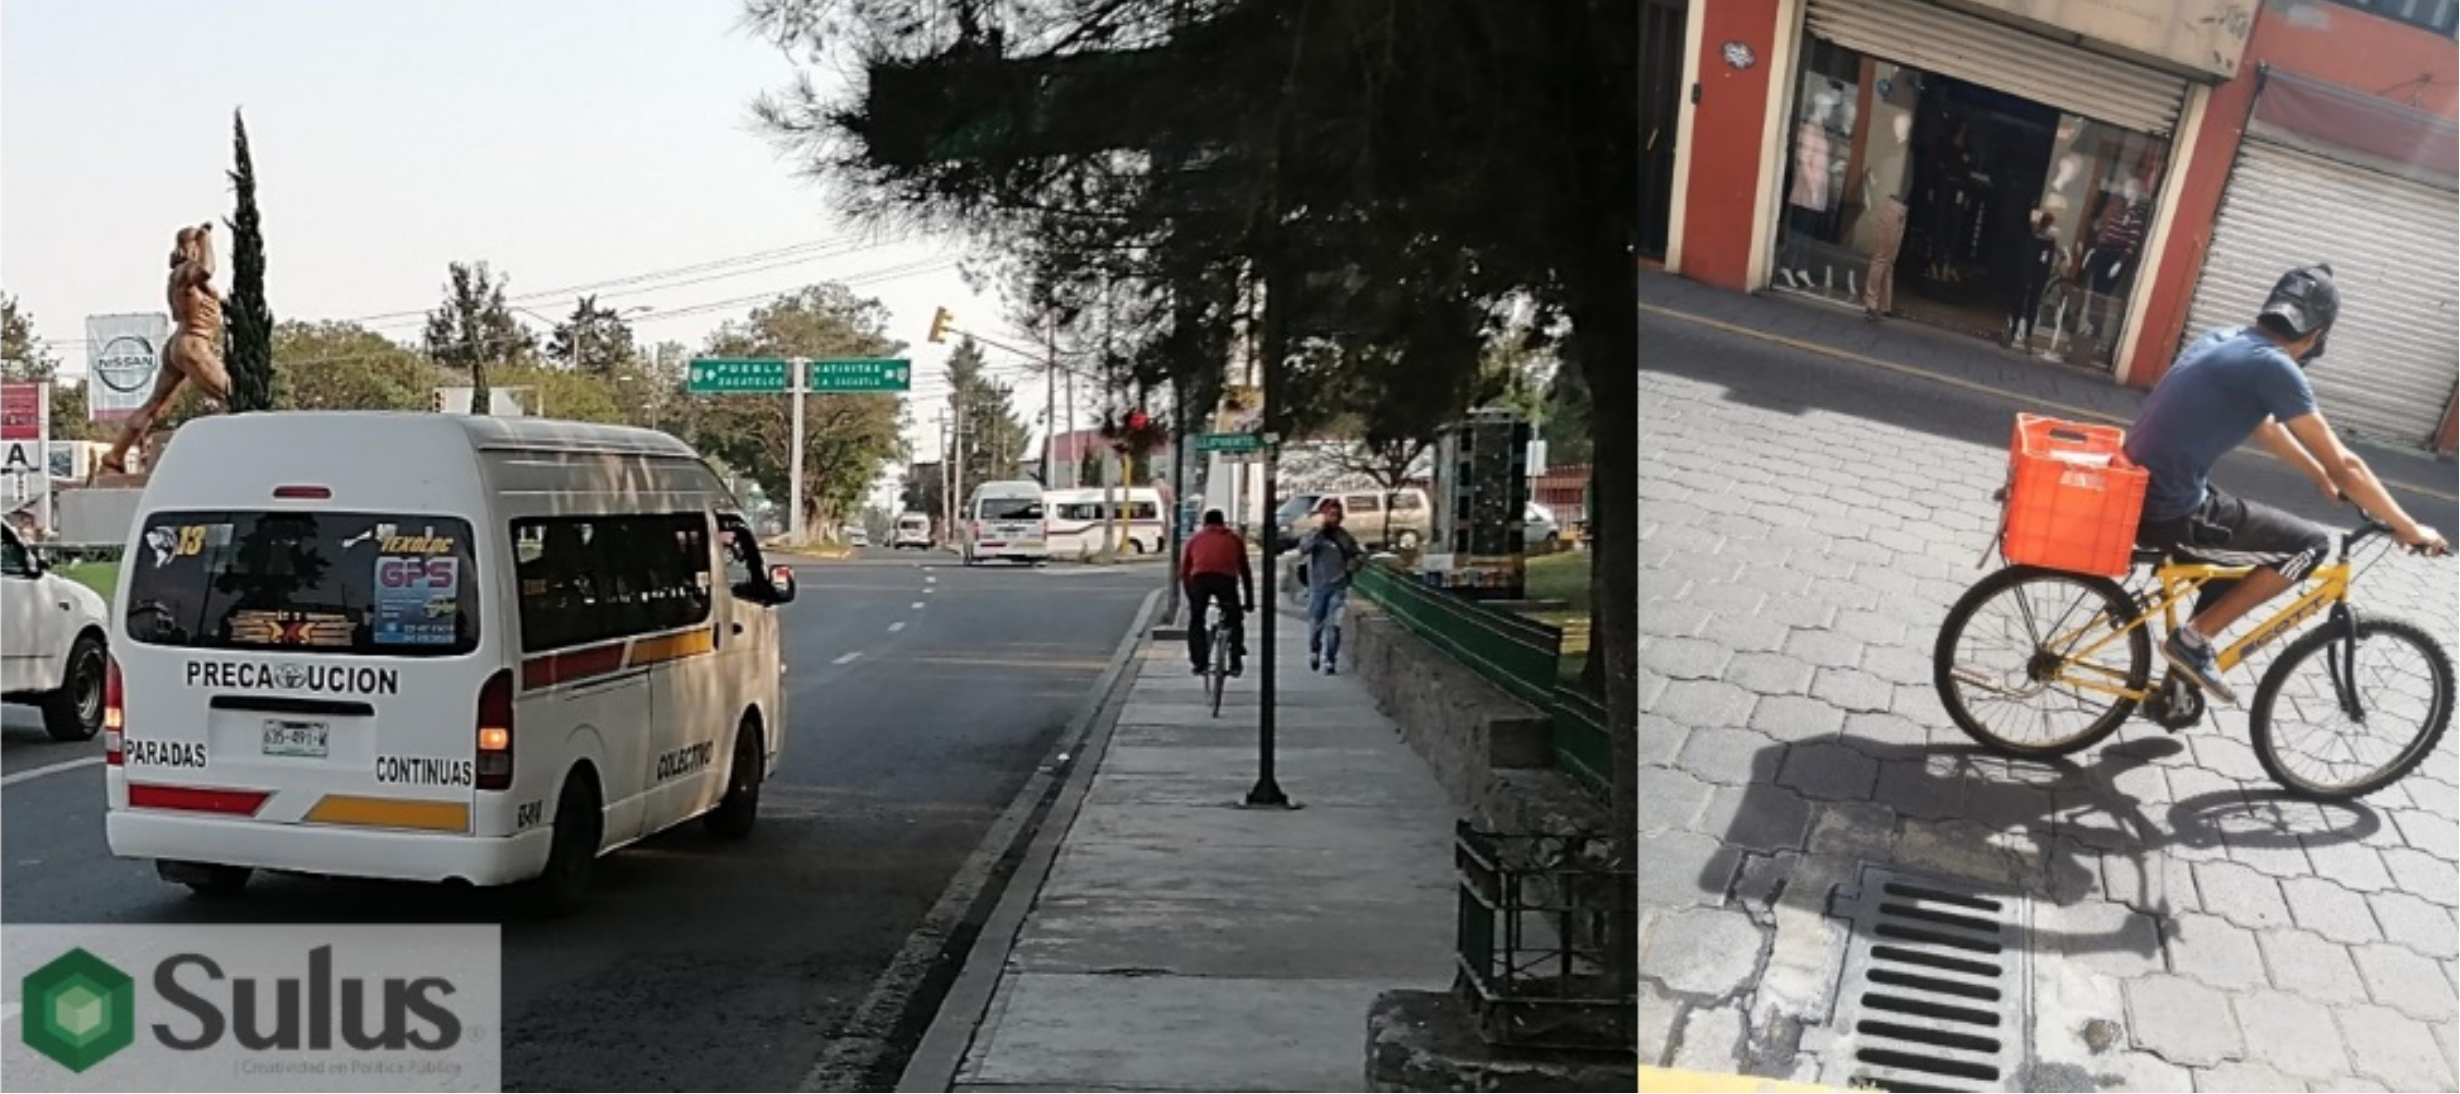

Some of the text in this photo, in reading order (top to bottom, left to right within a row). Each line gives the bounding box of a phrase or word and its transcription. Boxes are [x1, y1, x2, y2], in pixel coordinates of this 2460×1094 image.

[98, 355, 153, 369] NISSAN
[717, 364, 783, 374] PUEBLA
[717, 377, 783, 387] ZACATELCO
[177, 525, 204, 556] 13
[381, 536, 454, 553] TEXOLOC
[381, 560, 454, 588] GPS
[125, 739, 207, 768] PARADAS
[657, 741, 714, 781] COLECTIVO
[376, 756, 473, 787] CONTINUAS
